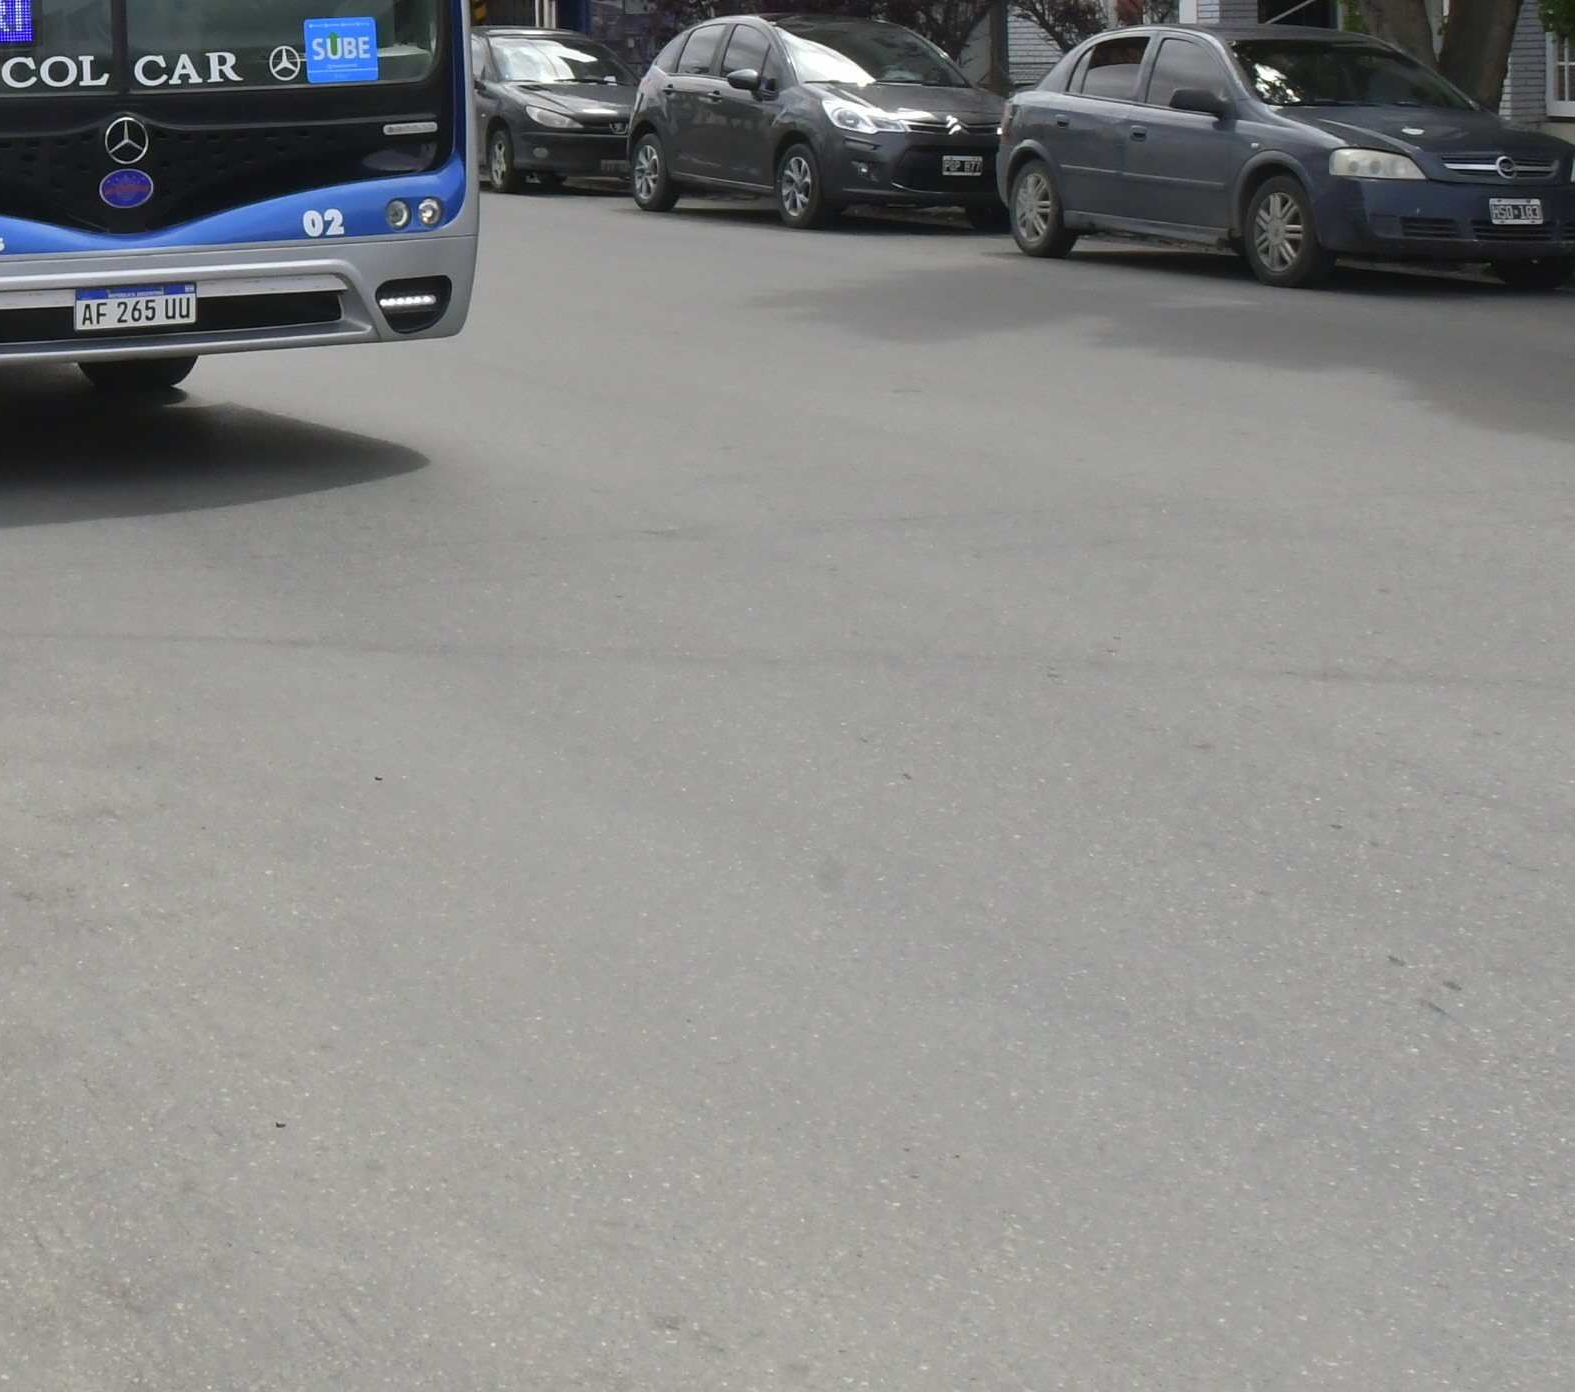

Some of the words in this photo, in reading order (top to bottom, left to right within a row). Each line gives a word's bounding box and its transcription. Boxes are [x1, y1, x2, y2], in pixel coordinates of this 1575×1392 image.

[311, 36, 371, 61] SUBE
[1, 55, 110, 89] COL
[133, 51, 244, 87] CAR
[964, 161, 981, 173] 877
[302, 208, 345, 237] 02
[1518, 205, 1540, 220] 183
[82, 302, 108, 325] AF
[117, 299, 156, 323] 265
[165, 297, 190, 320] UU
